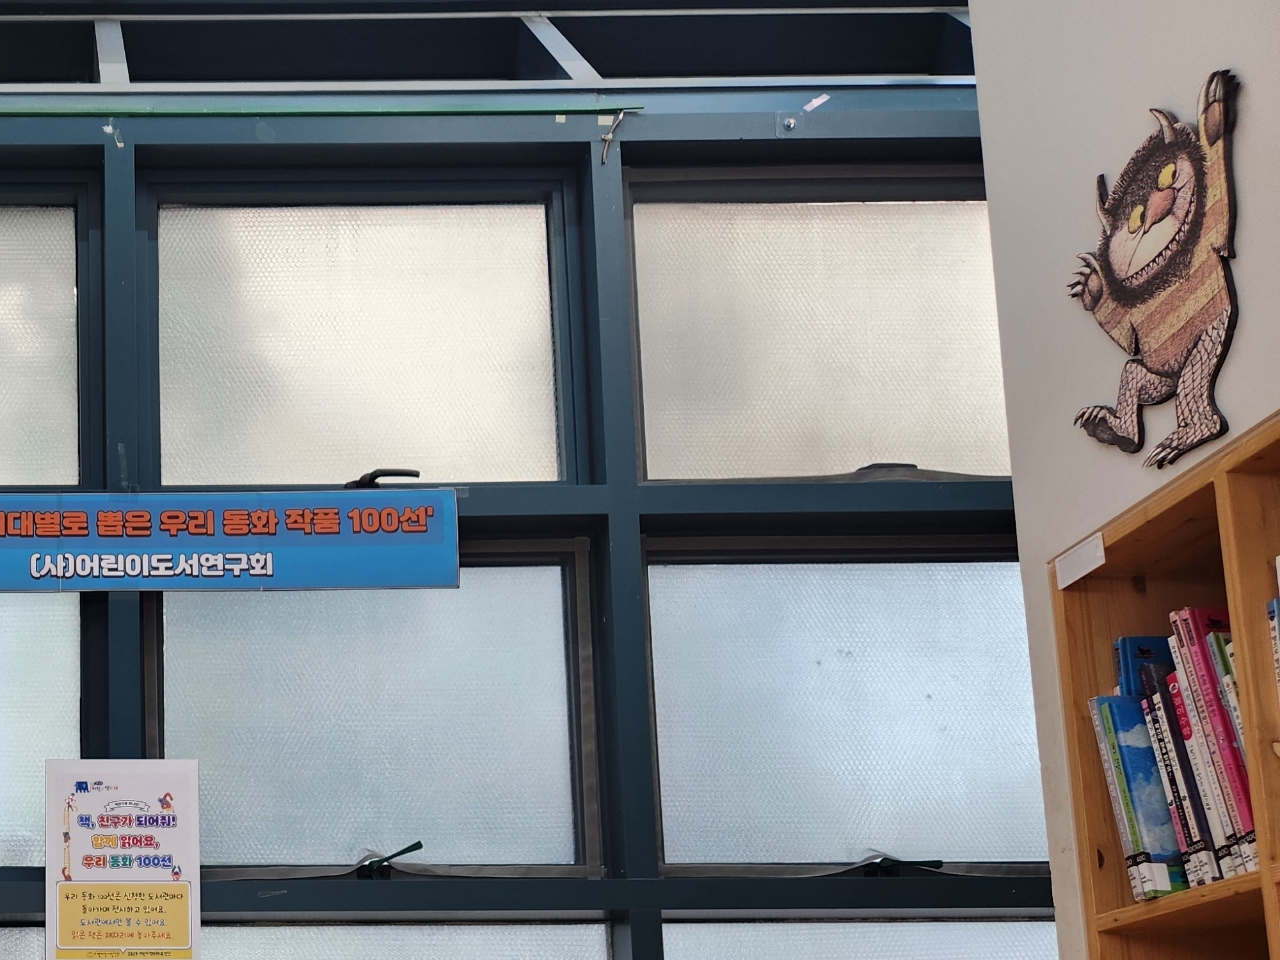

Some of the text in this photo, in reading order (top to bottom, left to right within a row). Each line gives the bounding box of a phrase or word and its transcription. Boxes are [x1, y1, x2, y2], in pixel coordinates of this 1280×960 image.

[96, 509, 155, 537] 뽑은
[159, 509, 214, 537] 우리
[222, 509, 278, 537] 동화
[285, 509, 341, 536] 작품
[30, 552, 274, 579] (사)어린이도서연구회
[77, 814, 96, 829] 책,
[98, 814, 133, 828] 친구가
[91, 835, 160, 850] 함께 읽어요,
[82, 855, 173, 869] 우리 동화 100선
[65, 893, 78, 901] 우리
[81, 891, 95, 901] 동화
[123, 892, 145, 901] 신청한
[148, 892, 184, 901] 도서관마다
[82, 904, 110, 914] 돌아가며
[112, 904, 140, 913] 전시하고
[80, 918, 122, 927] 도서관에서만
[135, 918, 142, 927] 수
[71, 930, 86, 940] 읽은
[88, 930, 103, 940] 책은
[105, 931, 135, 939] 제자리에
